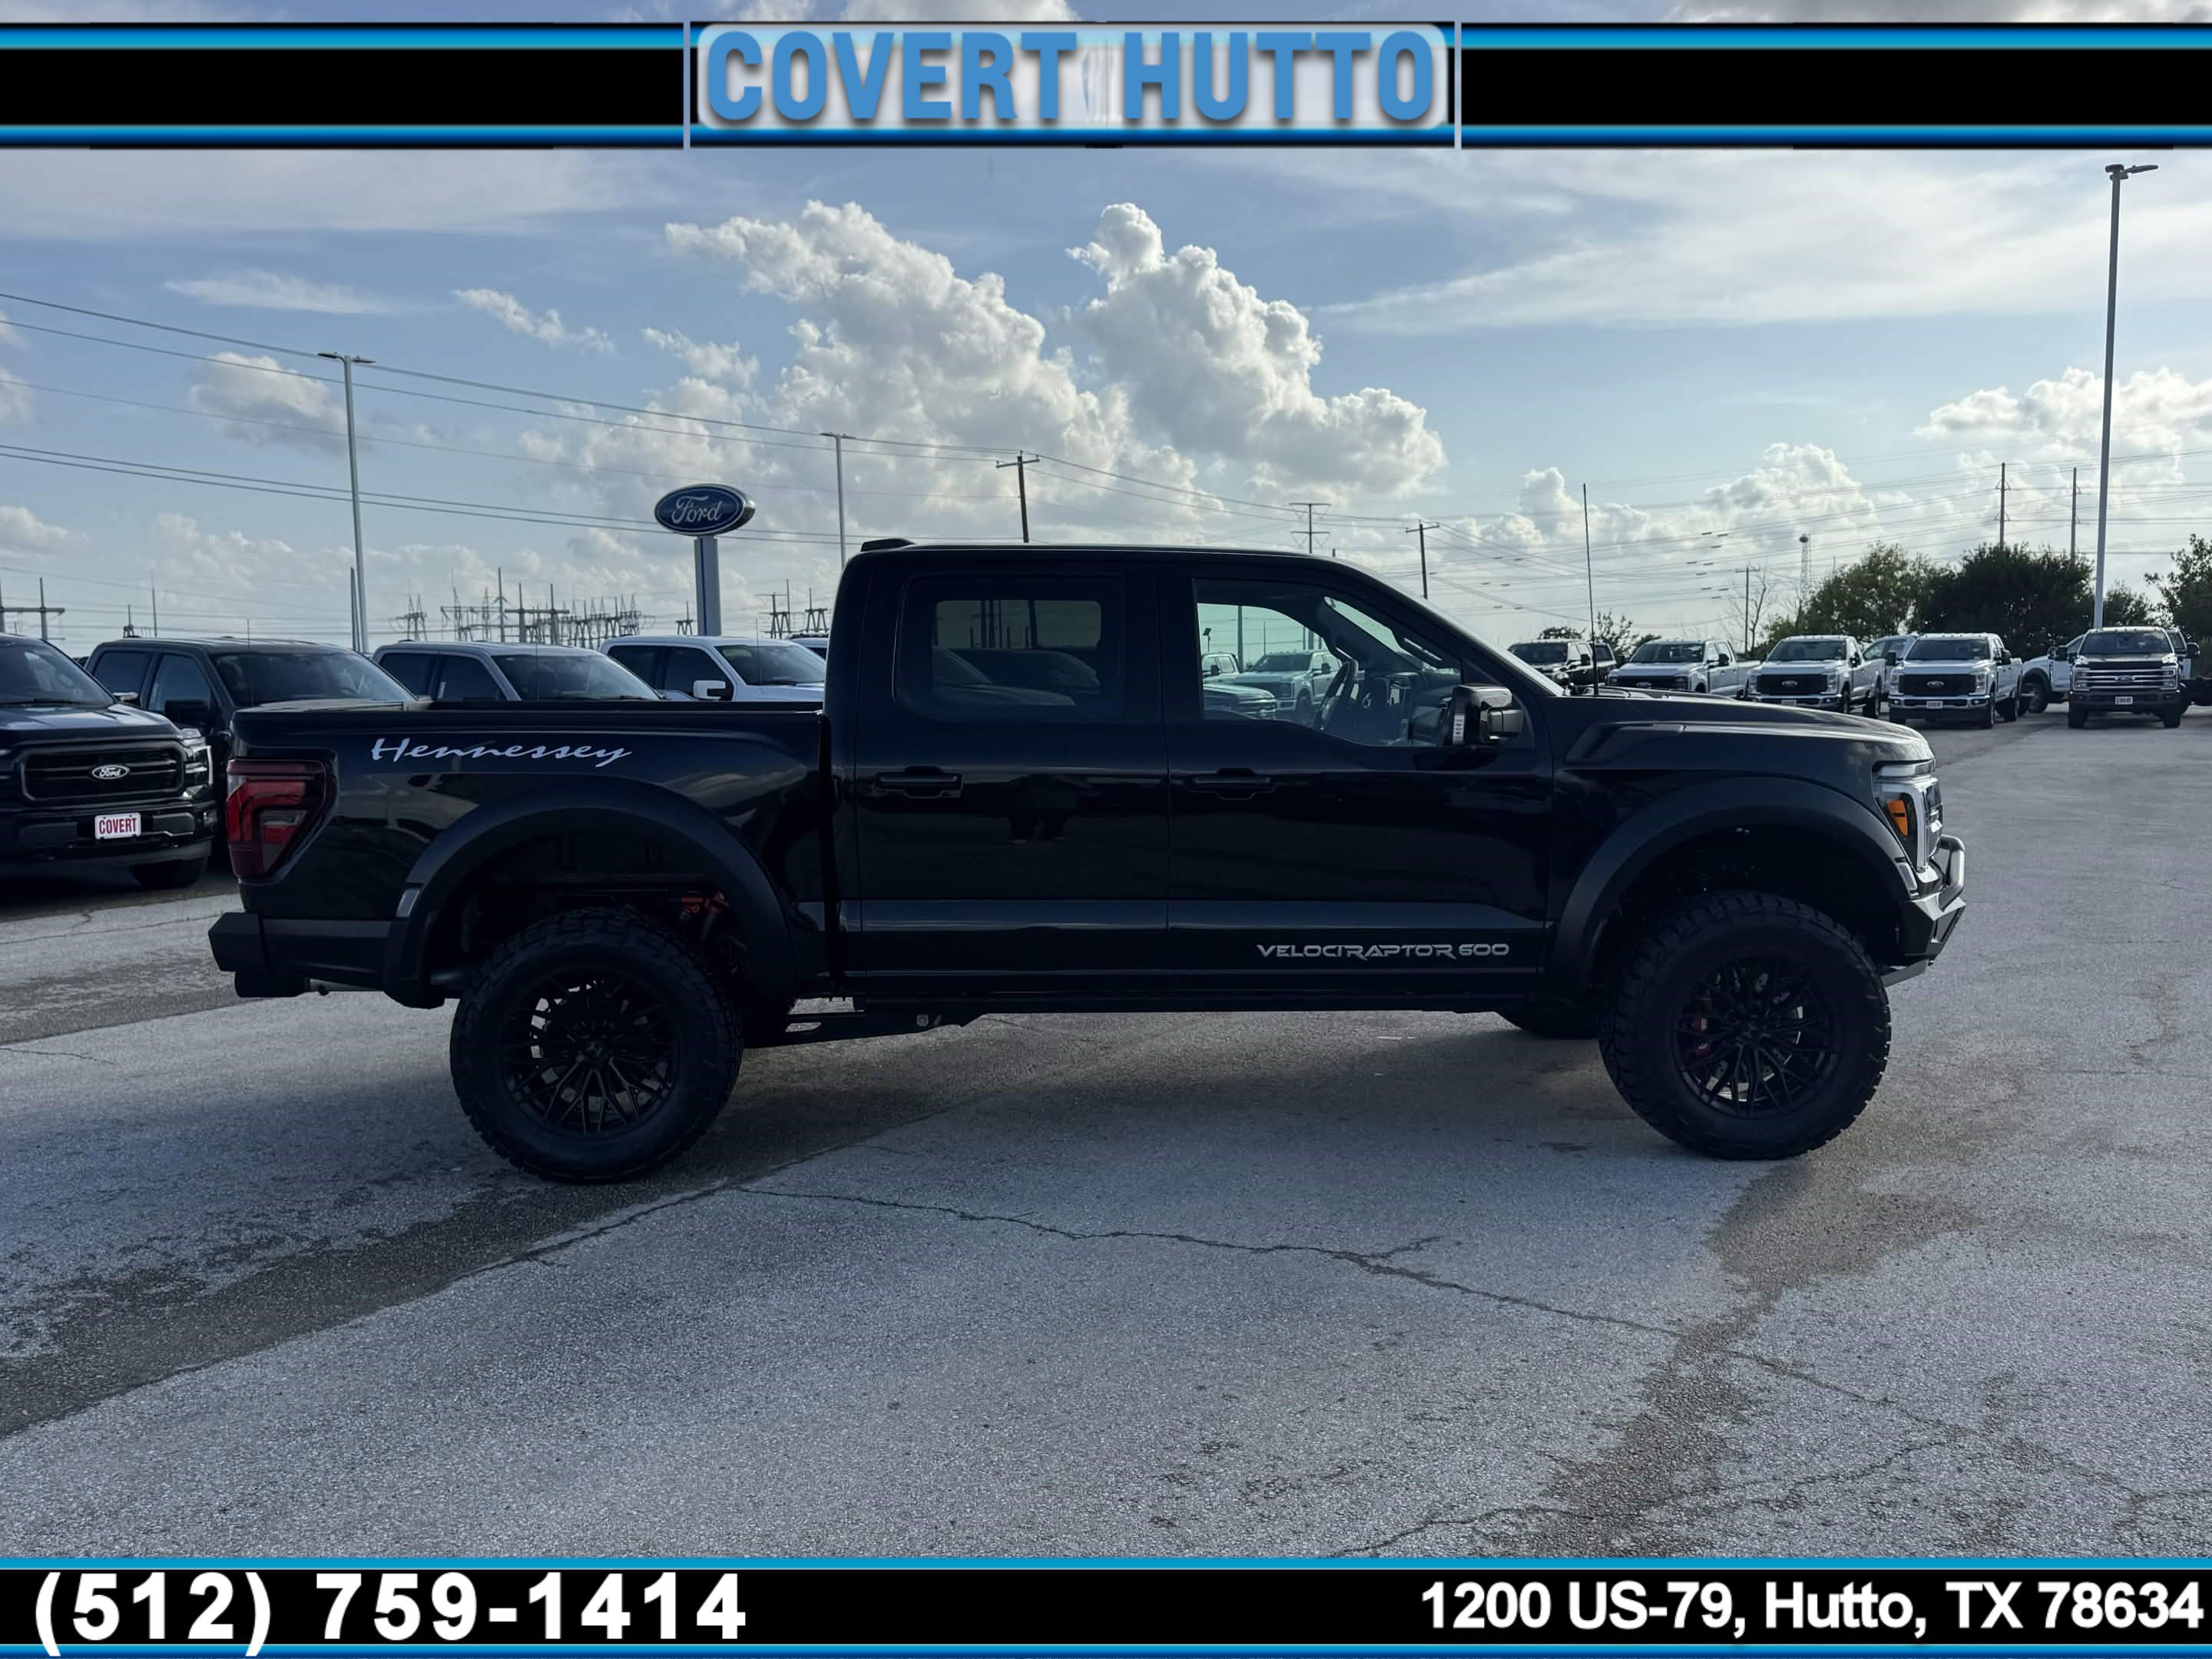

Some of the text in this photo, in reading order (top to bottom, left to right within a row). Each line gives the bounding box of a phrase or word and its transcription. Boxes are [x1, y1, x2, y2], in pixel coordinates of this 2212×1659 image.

[671, 495, 723, 524] Ford
[370, 738, 633, 767] Hennessey
[99, 767, 121, 777] Ford
[98, 817, 137, 834] COVERT
[1257, 943, 1509, 960] VELOCIRAPTOR 600
